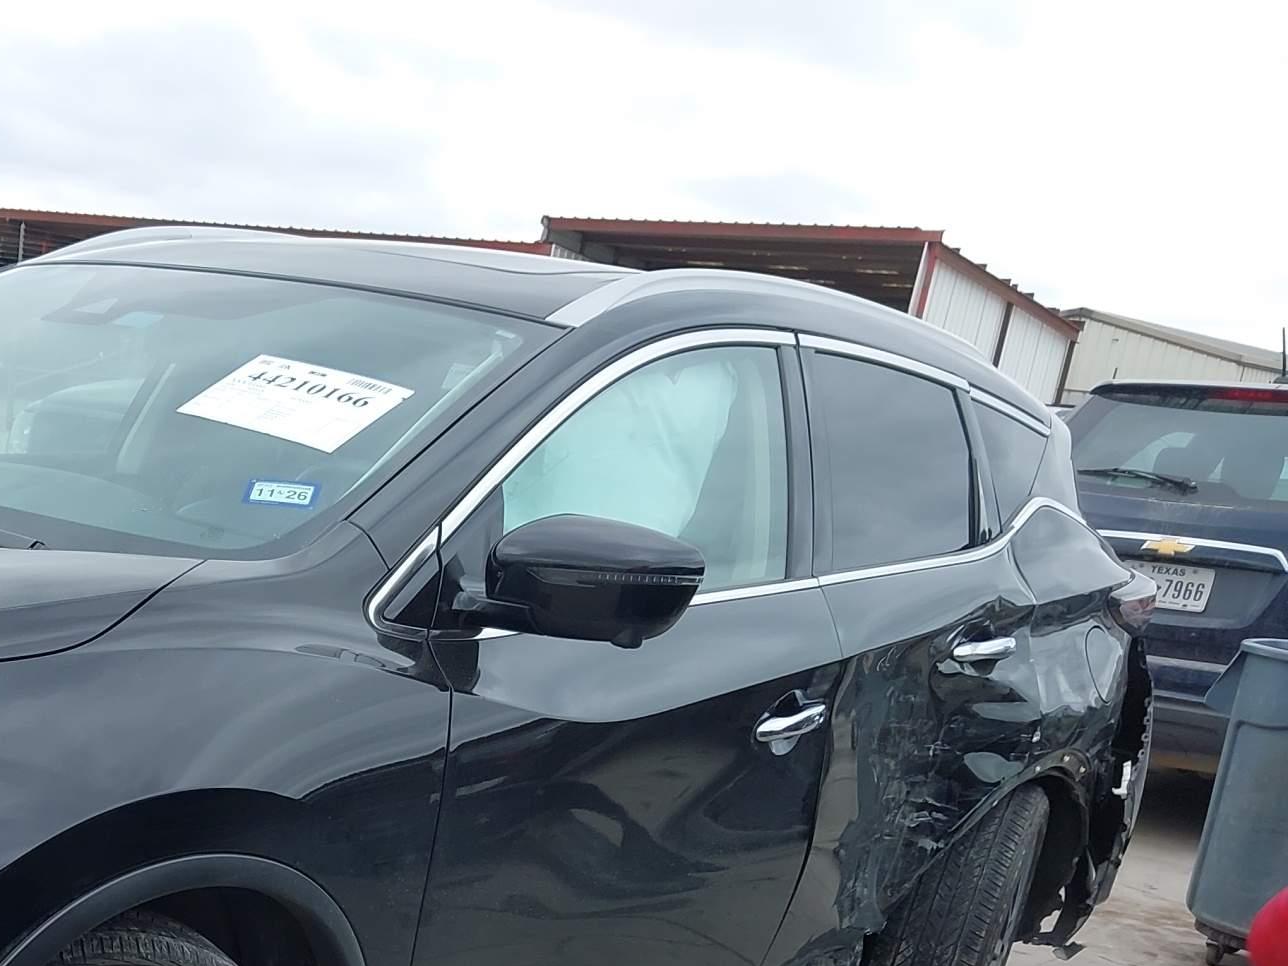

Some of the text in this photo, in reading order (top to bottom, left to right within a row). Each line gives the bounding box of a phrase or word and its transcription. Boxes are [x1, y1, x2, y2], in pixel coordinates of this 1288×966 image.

[248, 371, 373, 408] 44210166
[285, 489, 309, 501] 26
[1152, 565, 1186, 577] TEXAS
[1162, 579, 1206, 602] 7966
